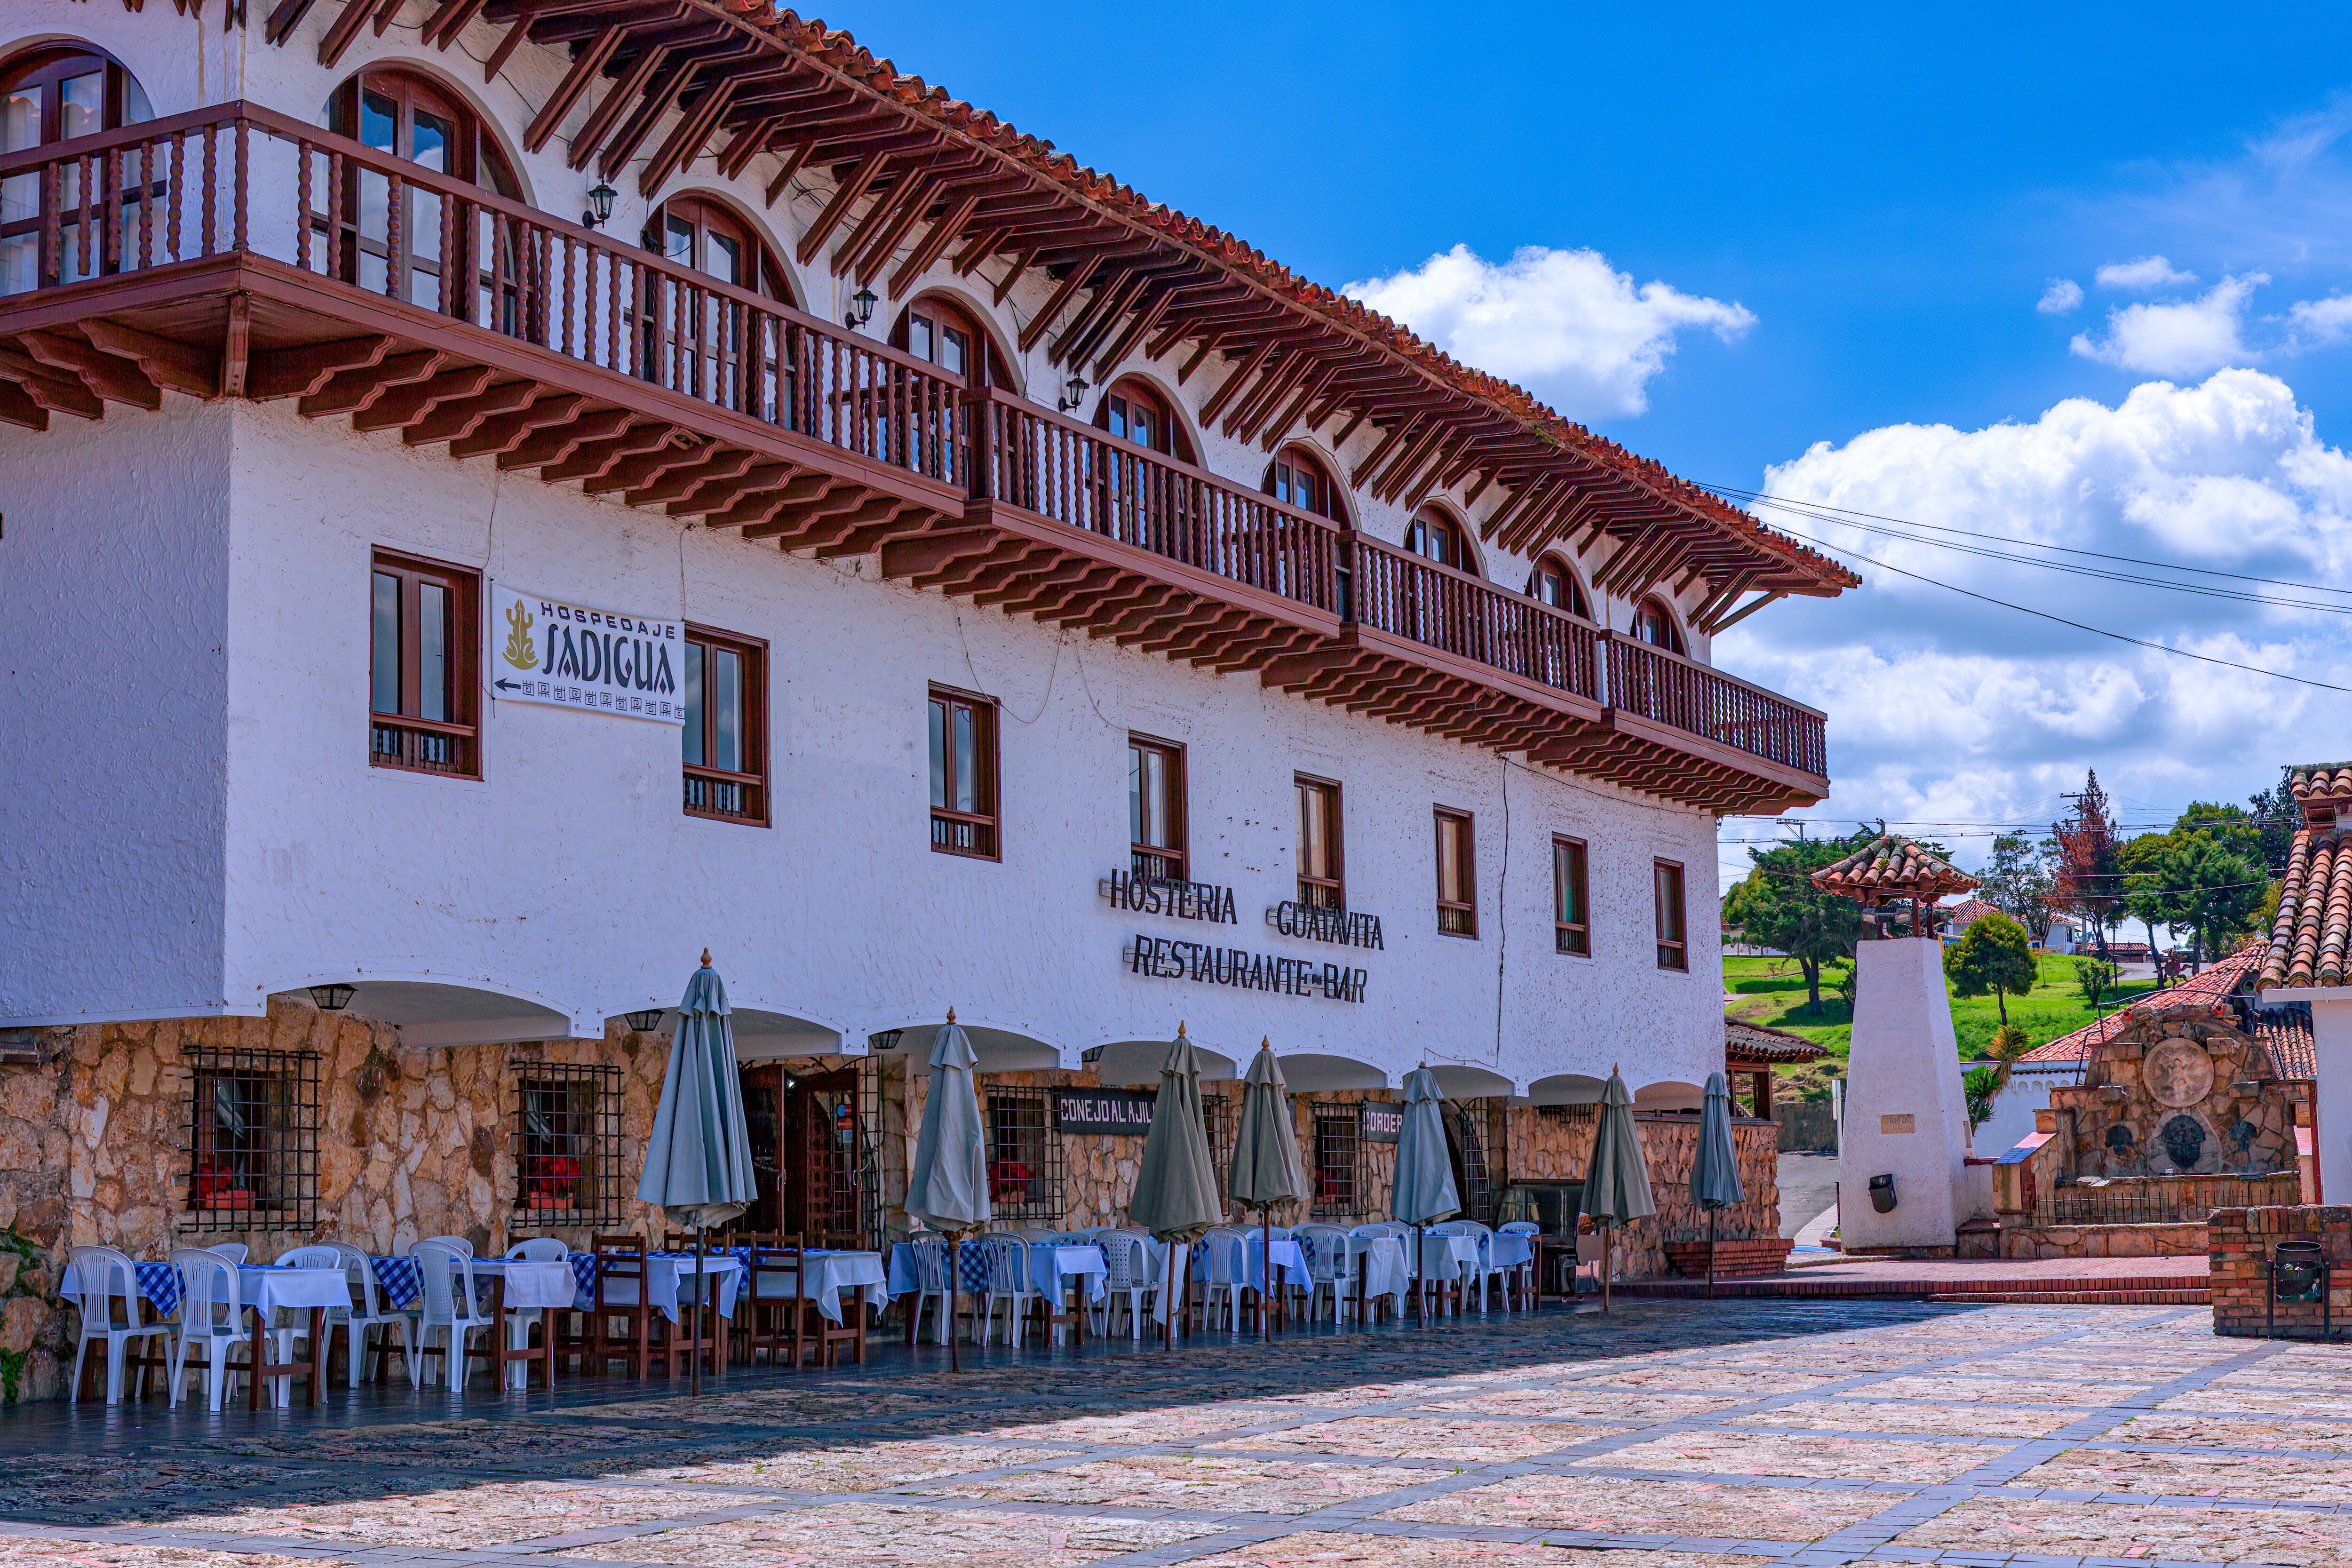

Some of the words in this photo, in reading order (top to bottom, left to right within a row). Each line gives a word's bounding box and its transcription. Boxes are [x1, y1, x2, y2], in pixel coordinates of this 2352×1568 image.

[540, 602, 675, 639] HOSPEDAJE
[542, 623, 675, 696] SADIGUA
[1110, 868, 1238, 925] HOSTERIA
[1276, 900, 1384, 951] GUATAVITA
[1061, 1099, 1110, 1122] CONEJO
[1112, 1100, 1127, 1122] AL
